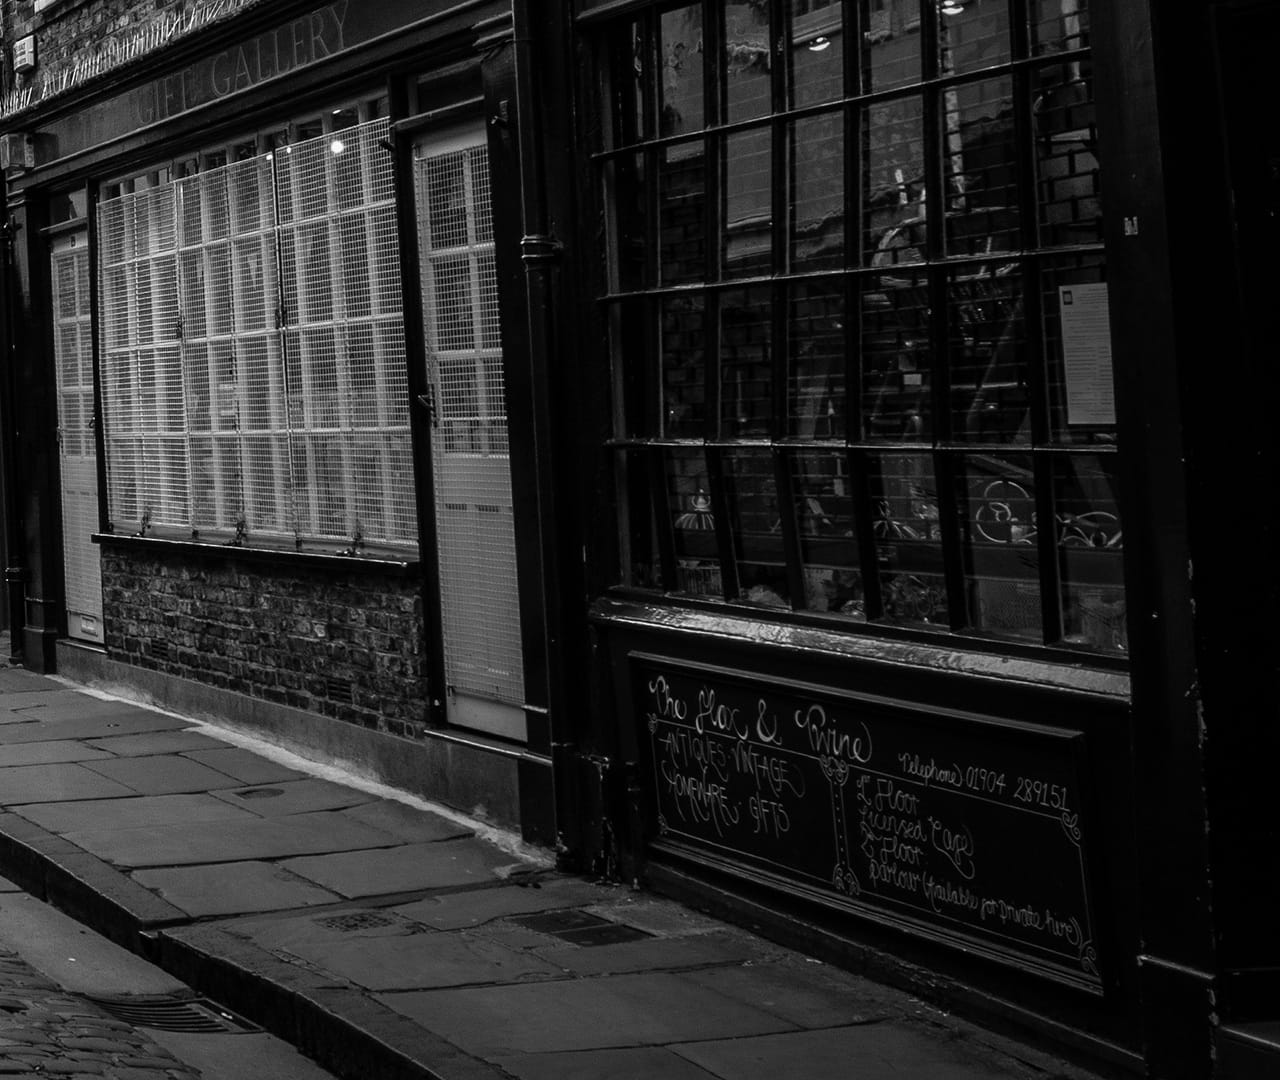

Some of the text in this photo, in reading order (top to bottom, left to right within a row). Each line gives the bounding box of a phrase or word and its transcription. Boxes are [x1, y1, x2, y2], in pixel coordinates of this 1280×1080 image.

[138, 0, 351, 125] GIFT GALLERY
[756, 698, 782, 746] &
[898, 752, 1071, 812] Telephone 01904 289151
